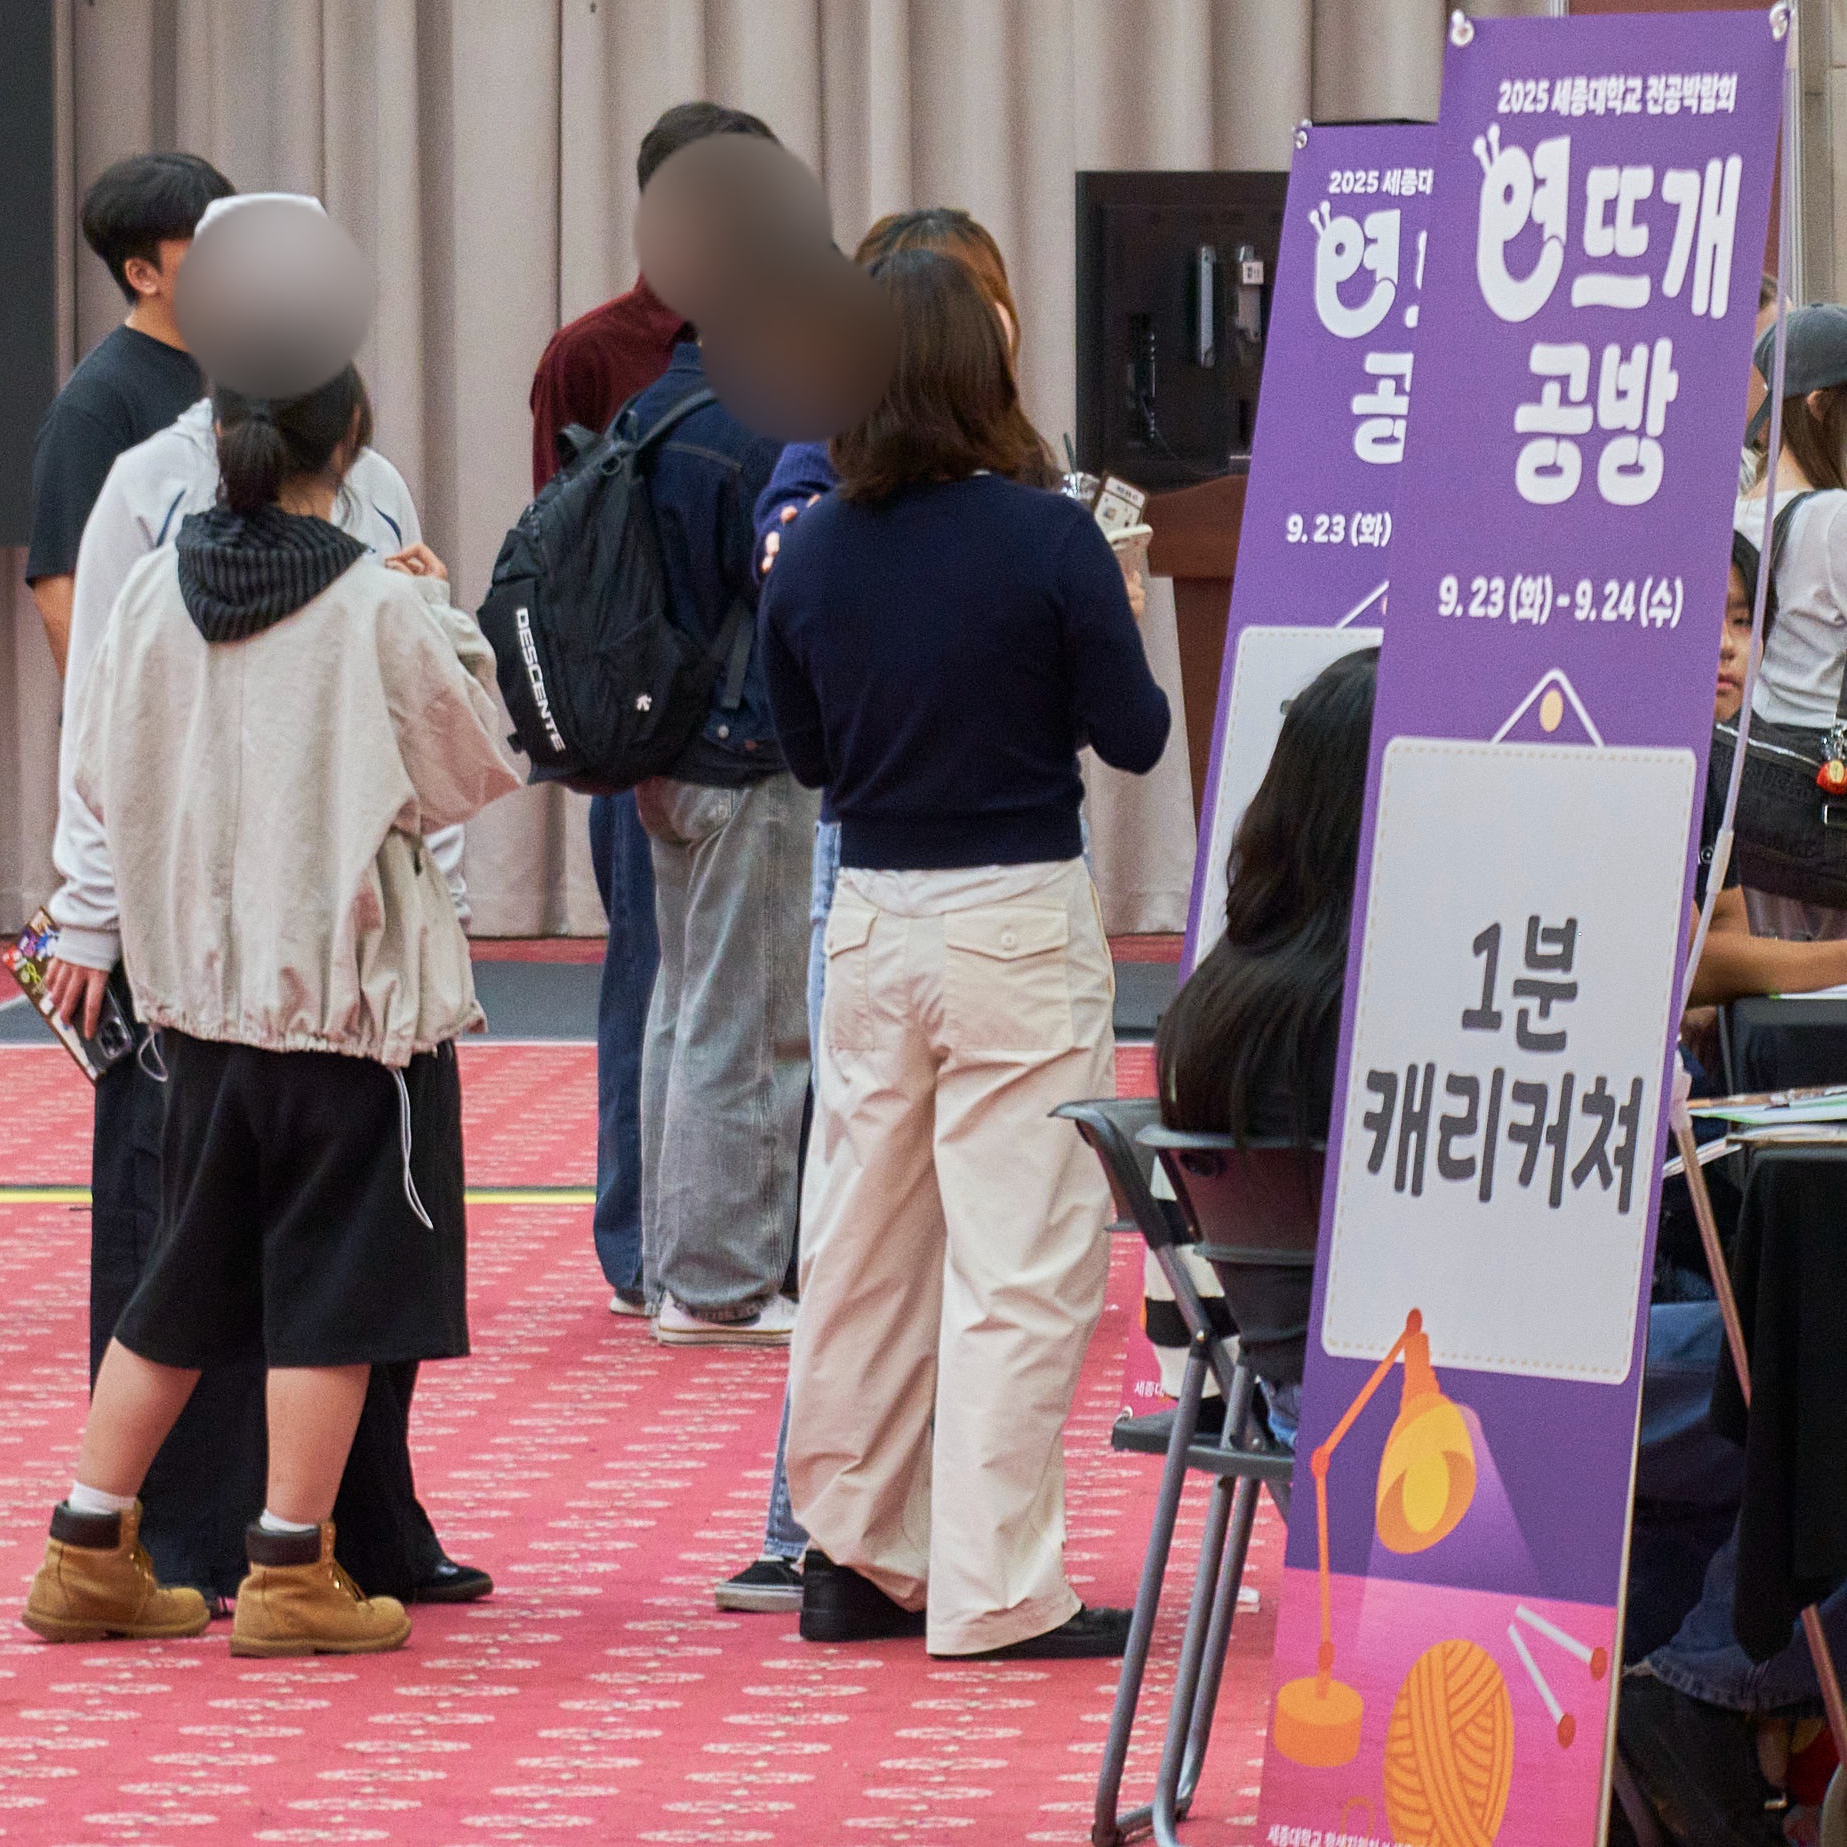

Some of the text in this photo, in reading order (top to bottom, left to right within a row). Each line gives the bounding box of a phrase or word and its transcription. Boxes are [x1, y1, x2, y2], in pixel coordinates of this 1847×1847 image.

[1499, 72, 1738, 115] 2025 세종대학교 전공박람회
[1329, 170, 1379, 194] 2025
[1571, 154, 1743, 319] 뜨개
[1514, 337, 1678, 506] 공방
[1286, 511, 1392, 547] 9. 23 (화)
[1438, 574, 1683, 629] 9. 23 (화) 9. 24 (수)
[516, 607, 567, 752] DESCENTE
[1461, 914, 1579, 1054] 1분
[1361, 1062, 1644, 1215] 캐리커쳐
